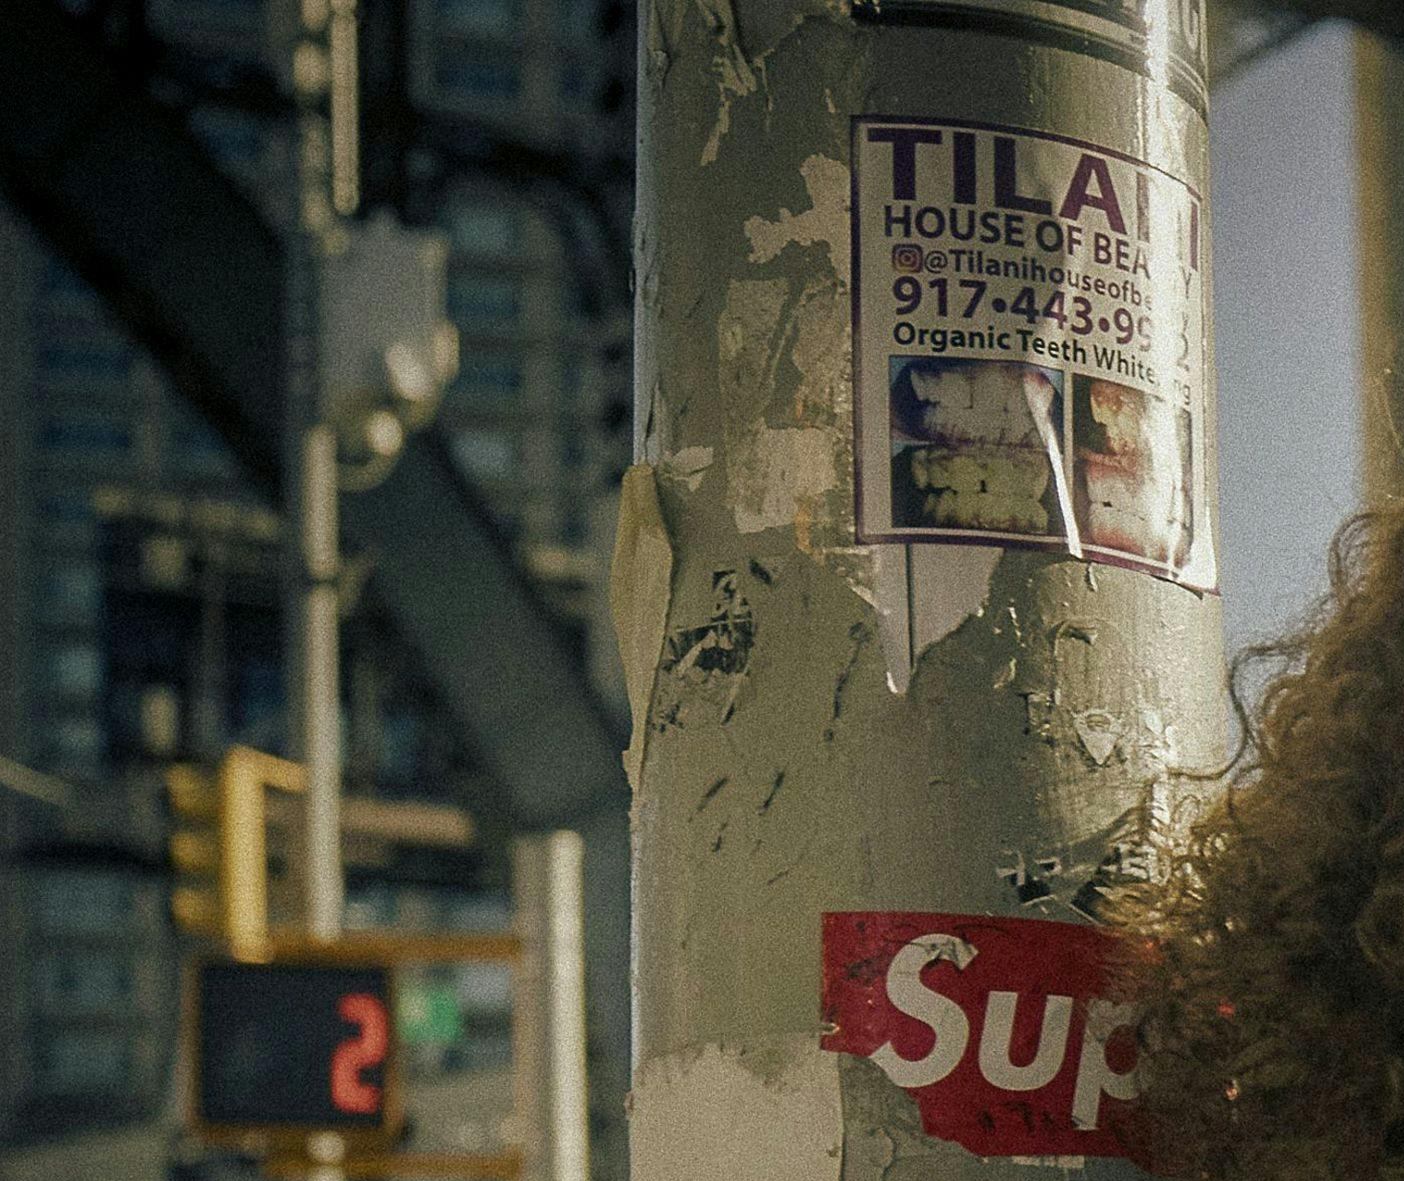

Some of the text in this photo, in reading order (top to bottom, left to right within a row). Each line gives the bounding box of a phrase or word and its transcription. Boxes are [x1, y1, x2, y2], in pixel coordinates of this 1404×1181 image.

[884, 205, 1193, 300] HOUSE OF BEAY
[892, 275, 1191, 373] 917•443•992
[893, 321, 1191, 405] Organic Teeth Whiteng
[331, 993, 389, 1114] 2
